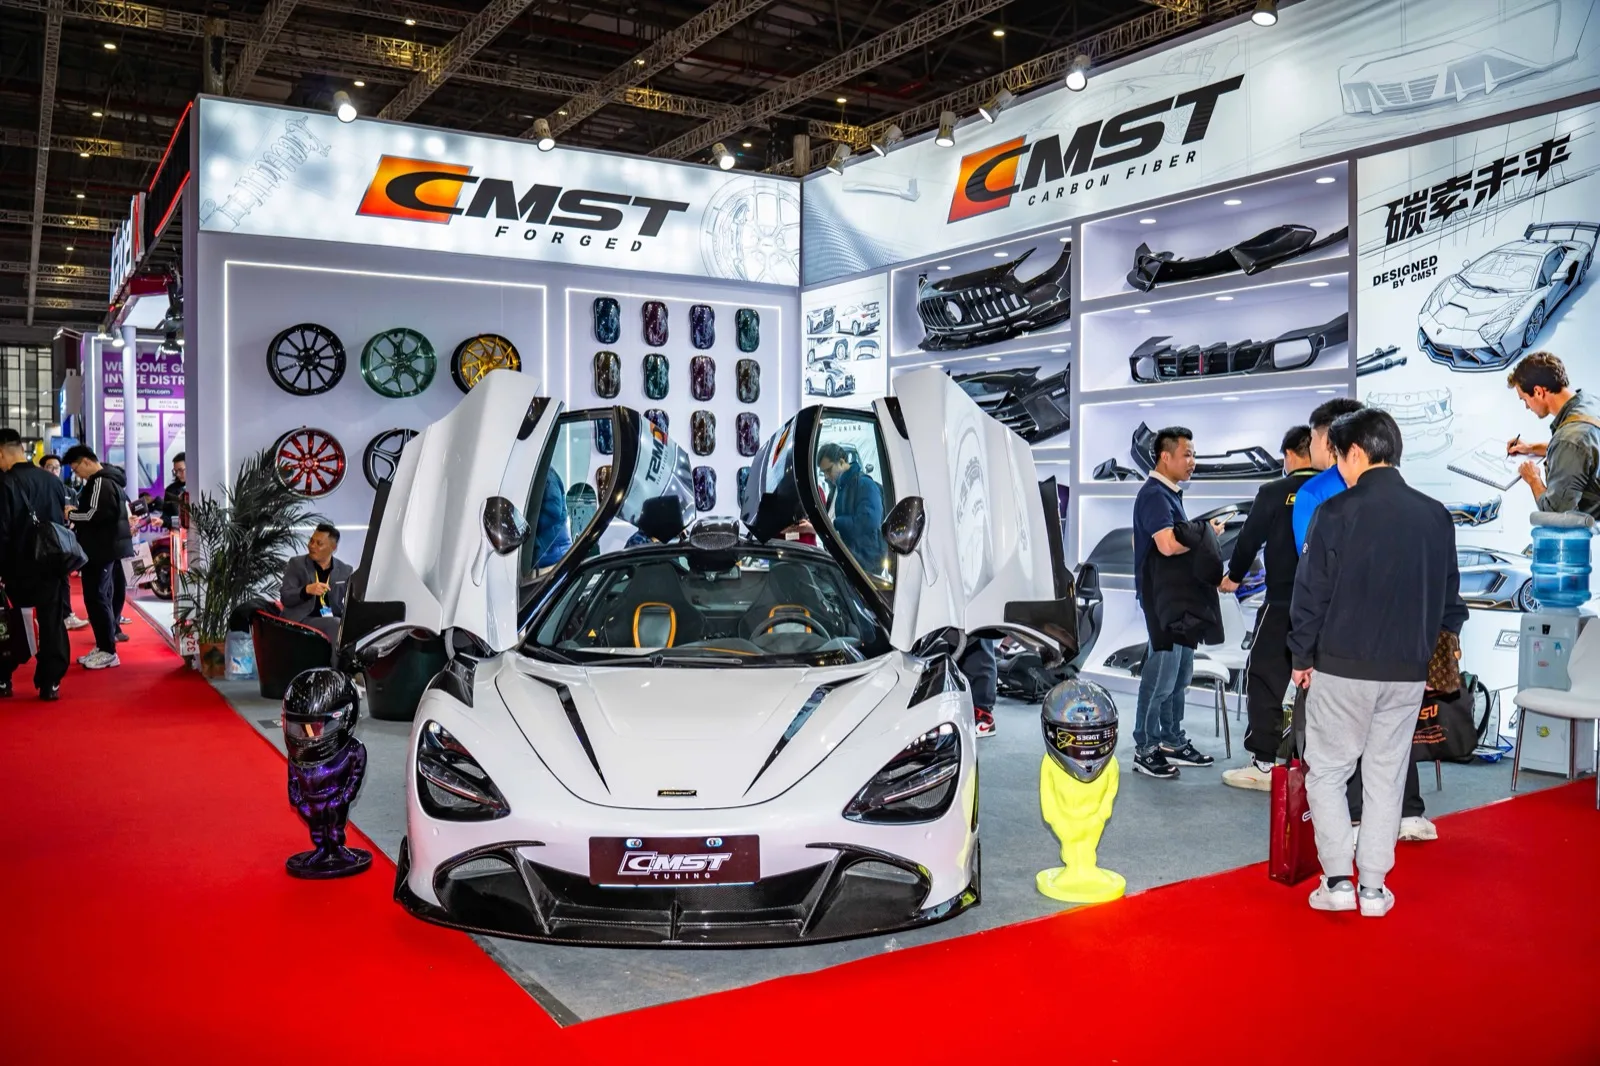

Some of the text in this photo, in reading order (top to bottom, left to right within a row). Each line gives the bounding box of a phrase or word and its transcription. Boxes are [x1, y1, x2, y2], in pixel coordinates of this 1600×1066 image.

[964, 73, 1245, 203] CMST
[1028, 150, 1197, 206] CARBON FIBER
[385, 170, 690, 238] CMST
[494, 225, 643, 253] FORGED
[1372, 255, 1438, 287] DESIGNED
[1392, 267, 1438, 289] BY CMST
[105, 361, 167, 373] WEOME
[622, 851, 732, 872] CMST
[653, 872, 710, 880] TUNING
